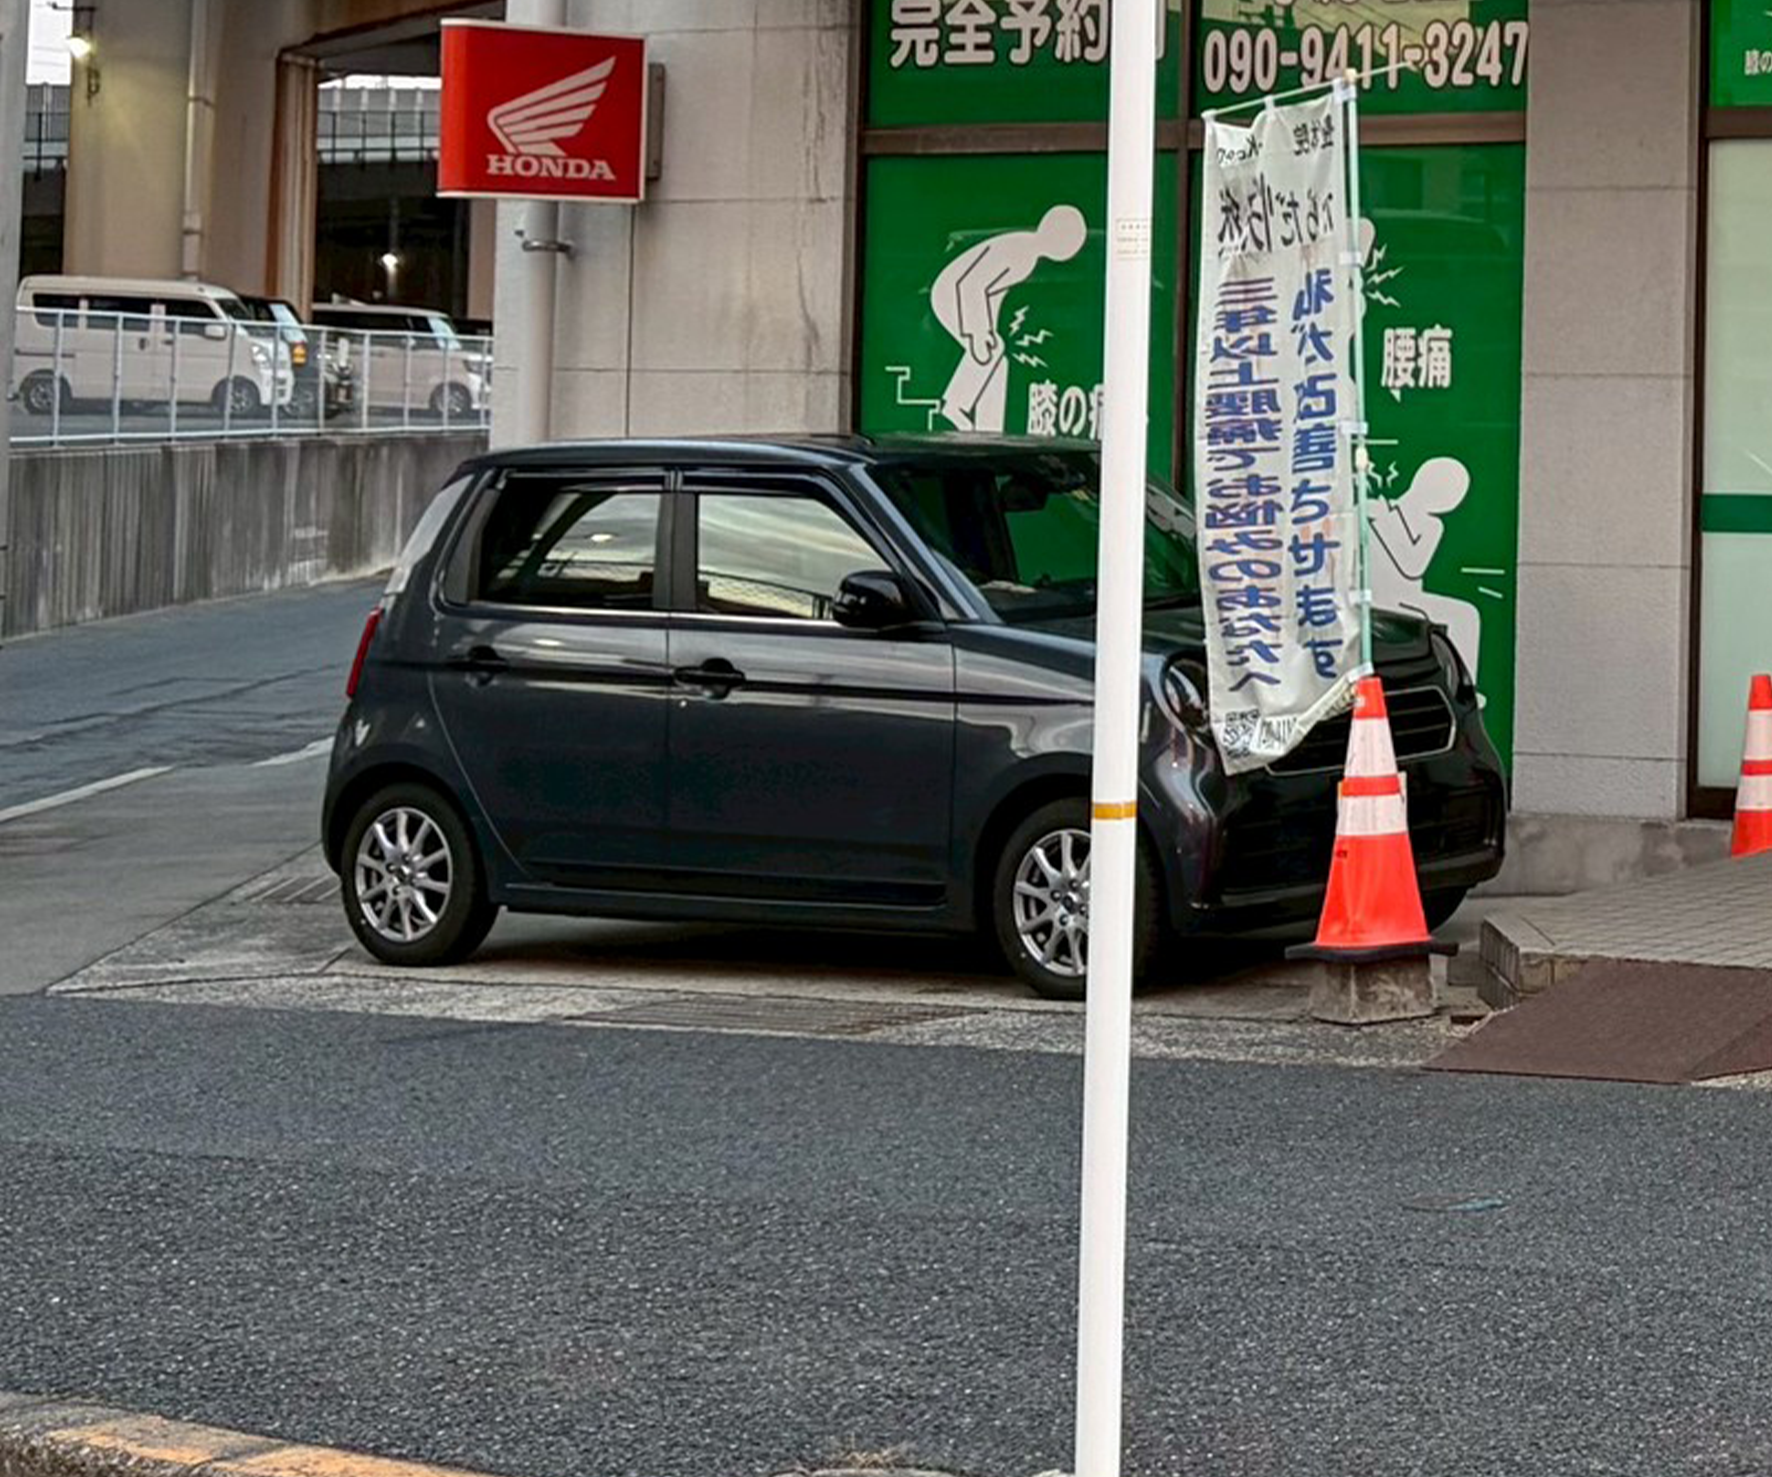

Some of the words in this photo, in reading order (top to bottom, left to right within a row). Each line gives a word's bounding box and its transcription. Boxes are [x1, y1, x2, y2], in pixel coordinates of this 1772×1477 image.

[1203, 20, 1529, 94] 090-9411-3247
[486, 154, 617, 181] HONDA
[1381, 323, 1453, 389] 腰痛
